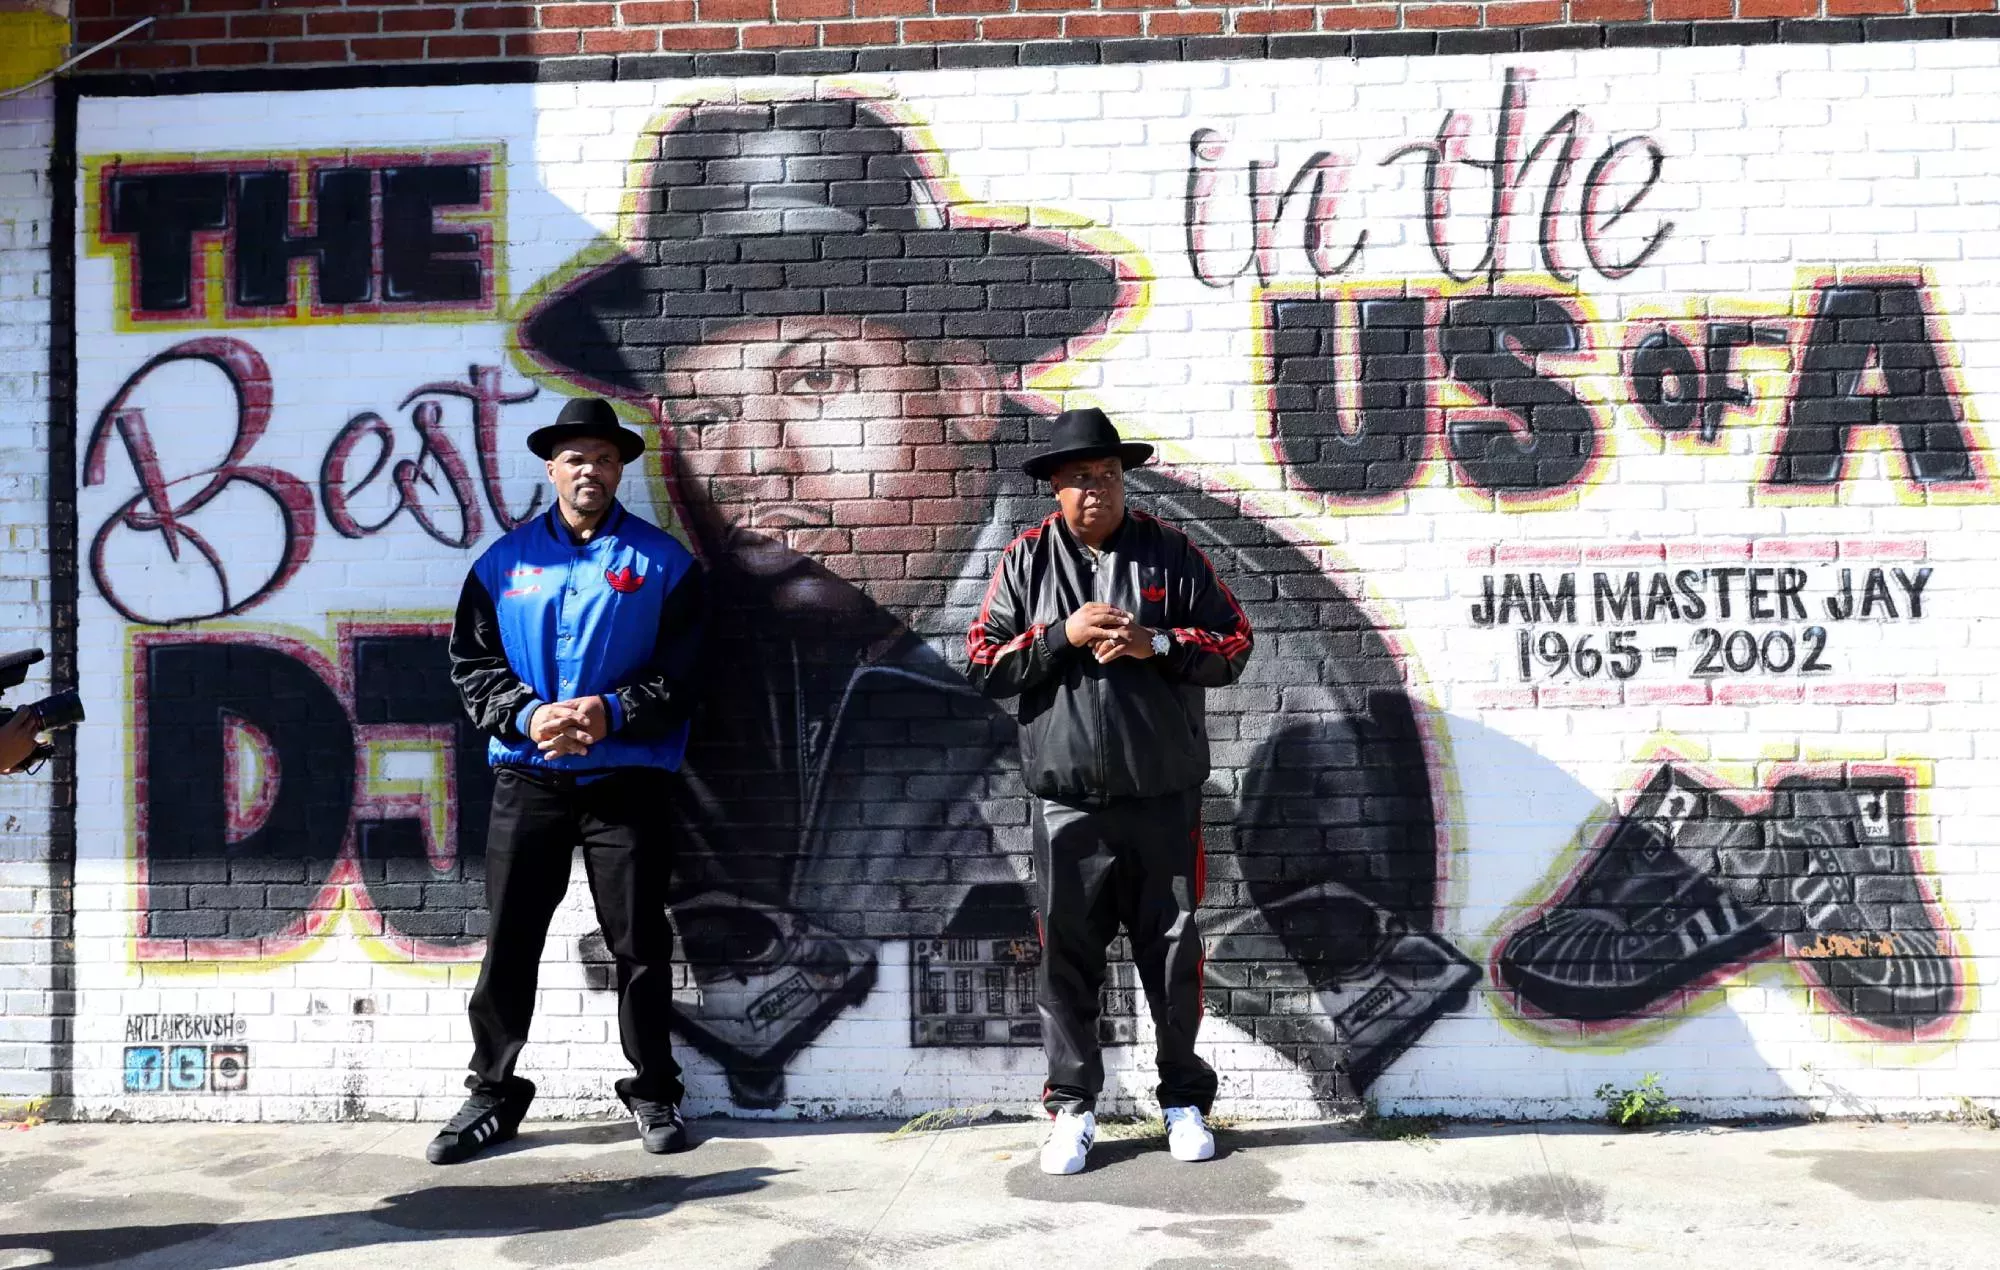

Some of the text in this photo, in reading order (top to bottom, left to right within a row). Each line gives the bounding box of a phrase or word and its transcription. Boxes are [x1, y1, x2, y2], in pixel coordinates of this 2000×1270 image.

[98, 148, 494, 322] THE
[1185, 66, 1676, 292] in the
[82, 335, 540, 626] Best
[1263, 290, 1602, 506] US
[1762, 272, 1990, 502] A
[1470, 565, 1935, 628] JAM MASTER JAY
